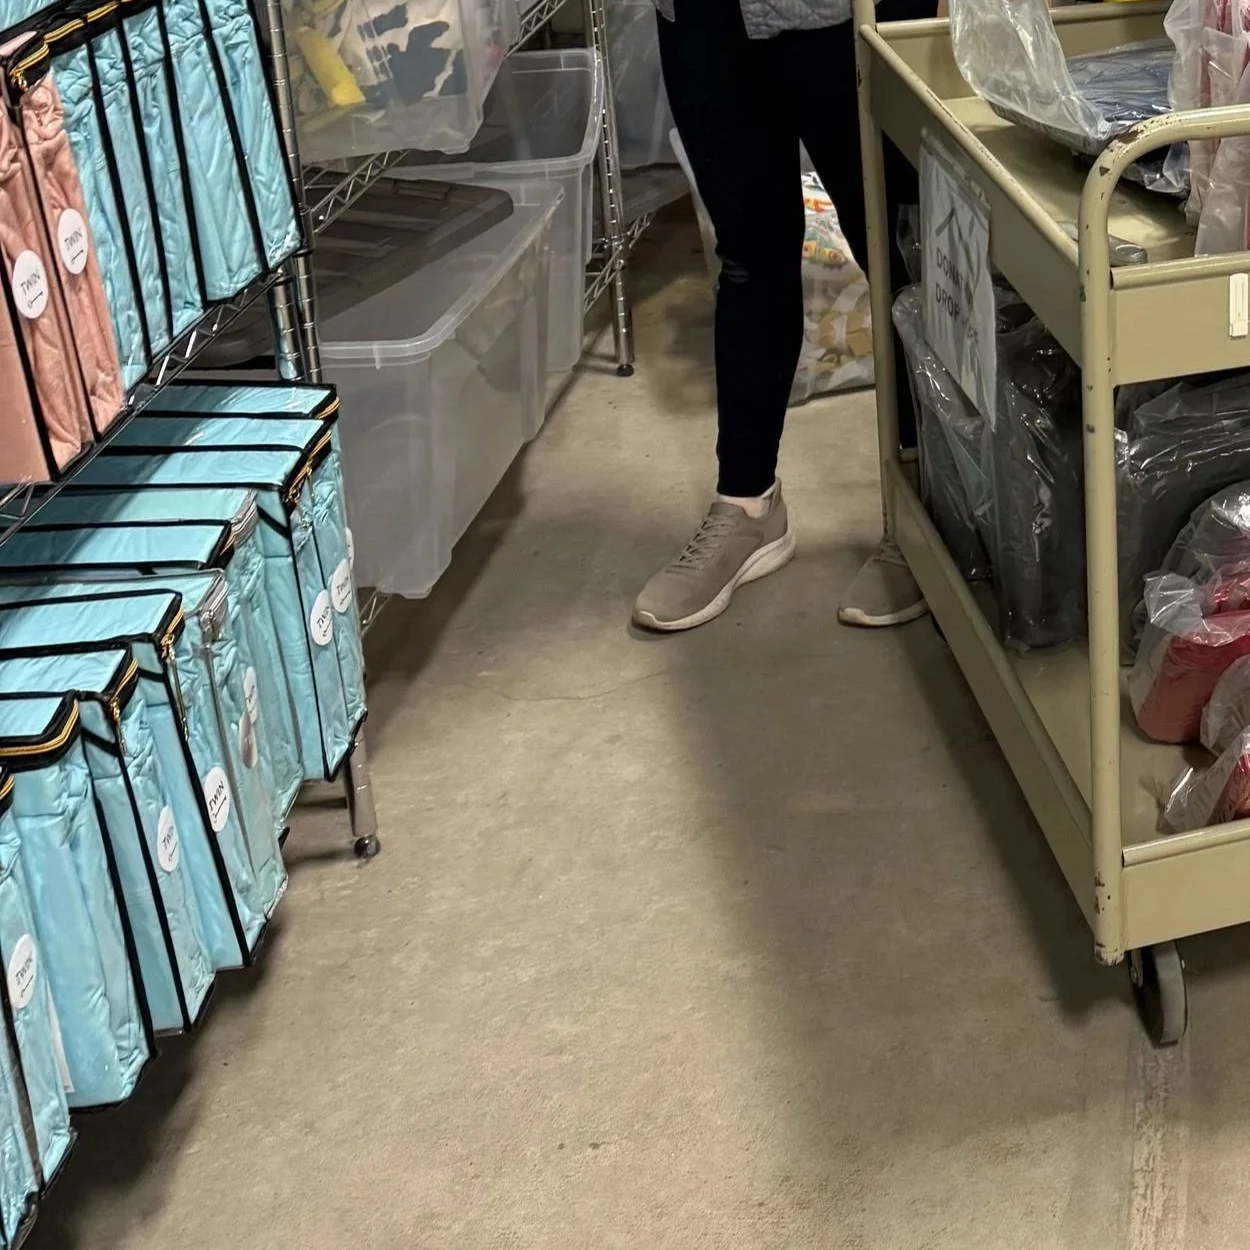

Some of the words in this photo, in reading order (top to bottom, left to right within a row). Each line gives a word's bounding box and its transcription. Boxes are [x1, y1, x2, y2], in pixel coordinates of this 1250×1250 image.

[64, 227, 83, 251] TWIN
[20, 269, 41, 296] TWIN
[208, 780, 224, 811] TWIN
[15, 953, 33, 986] TWIN
